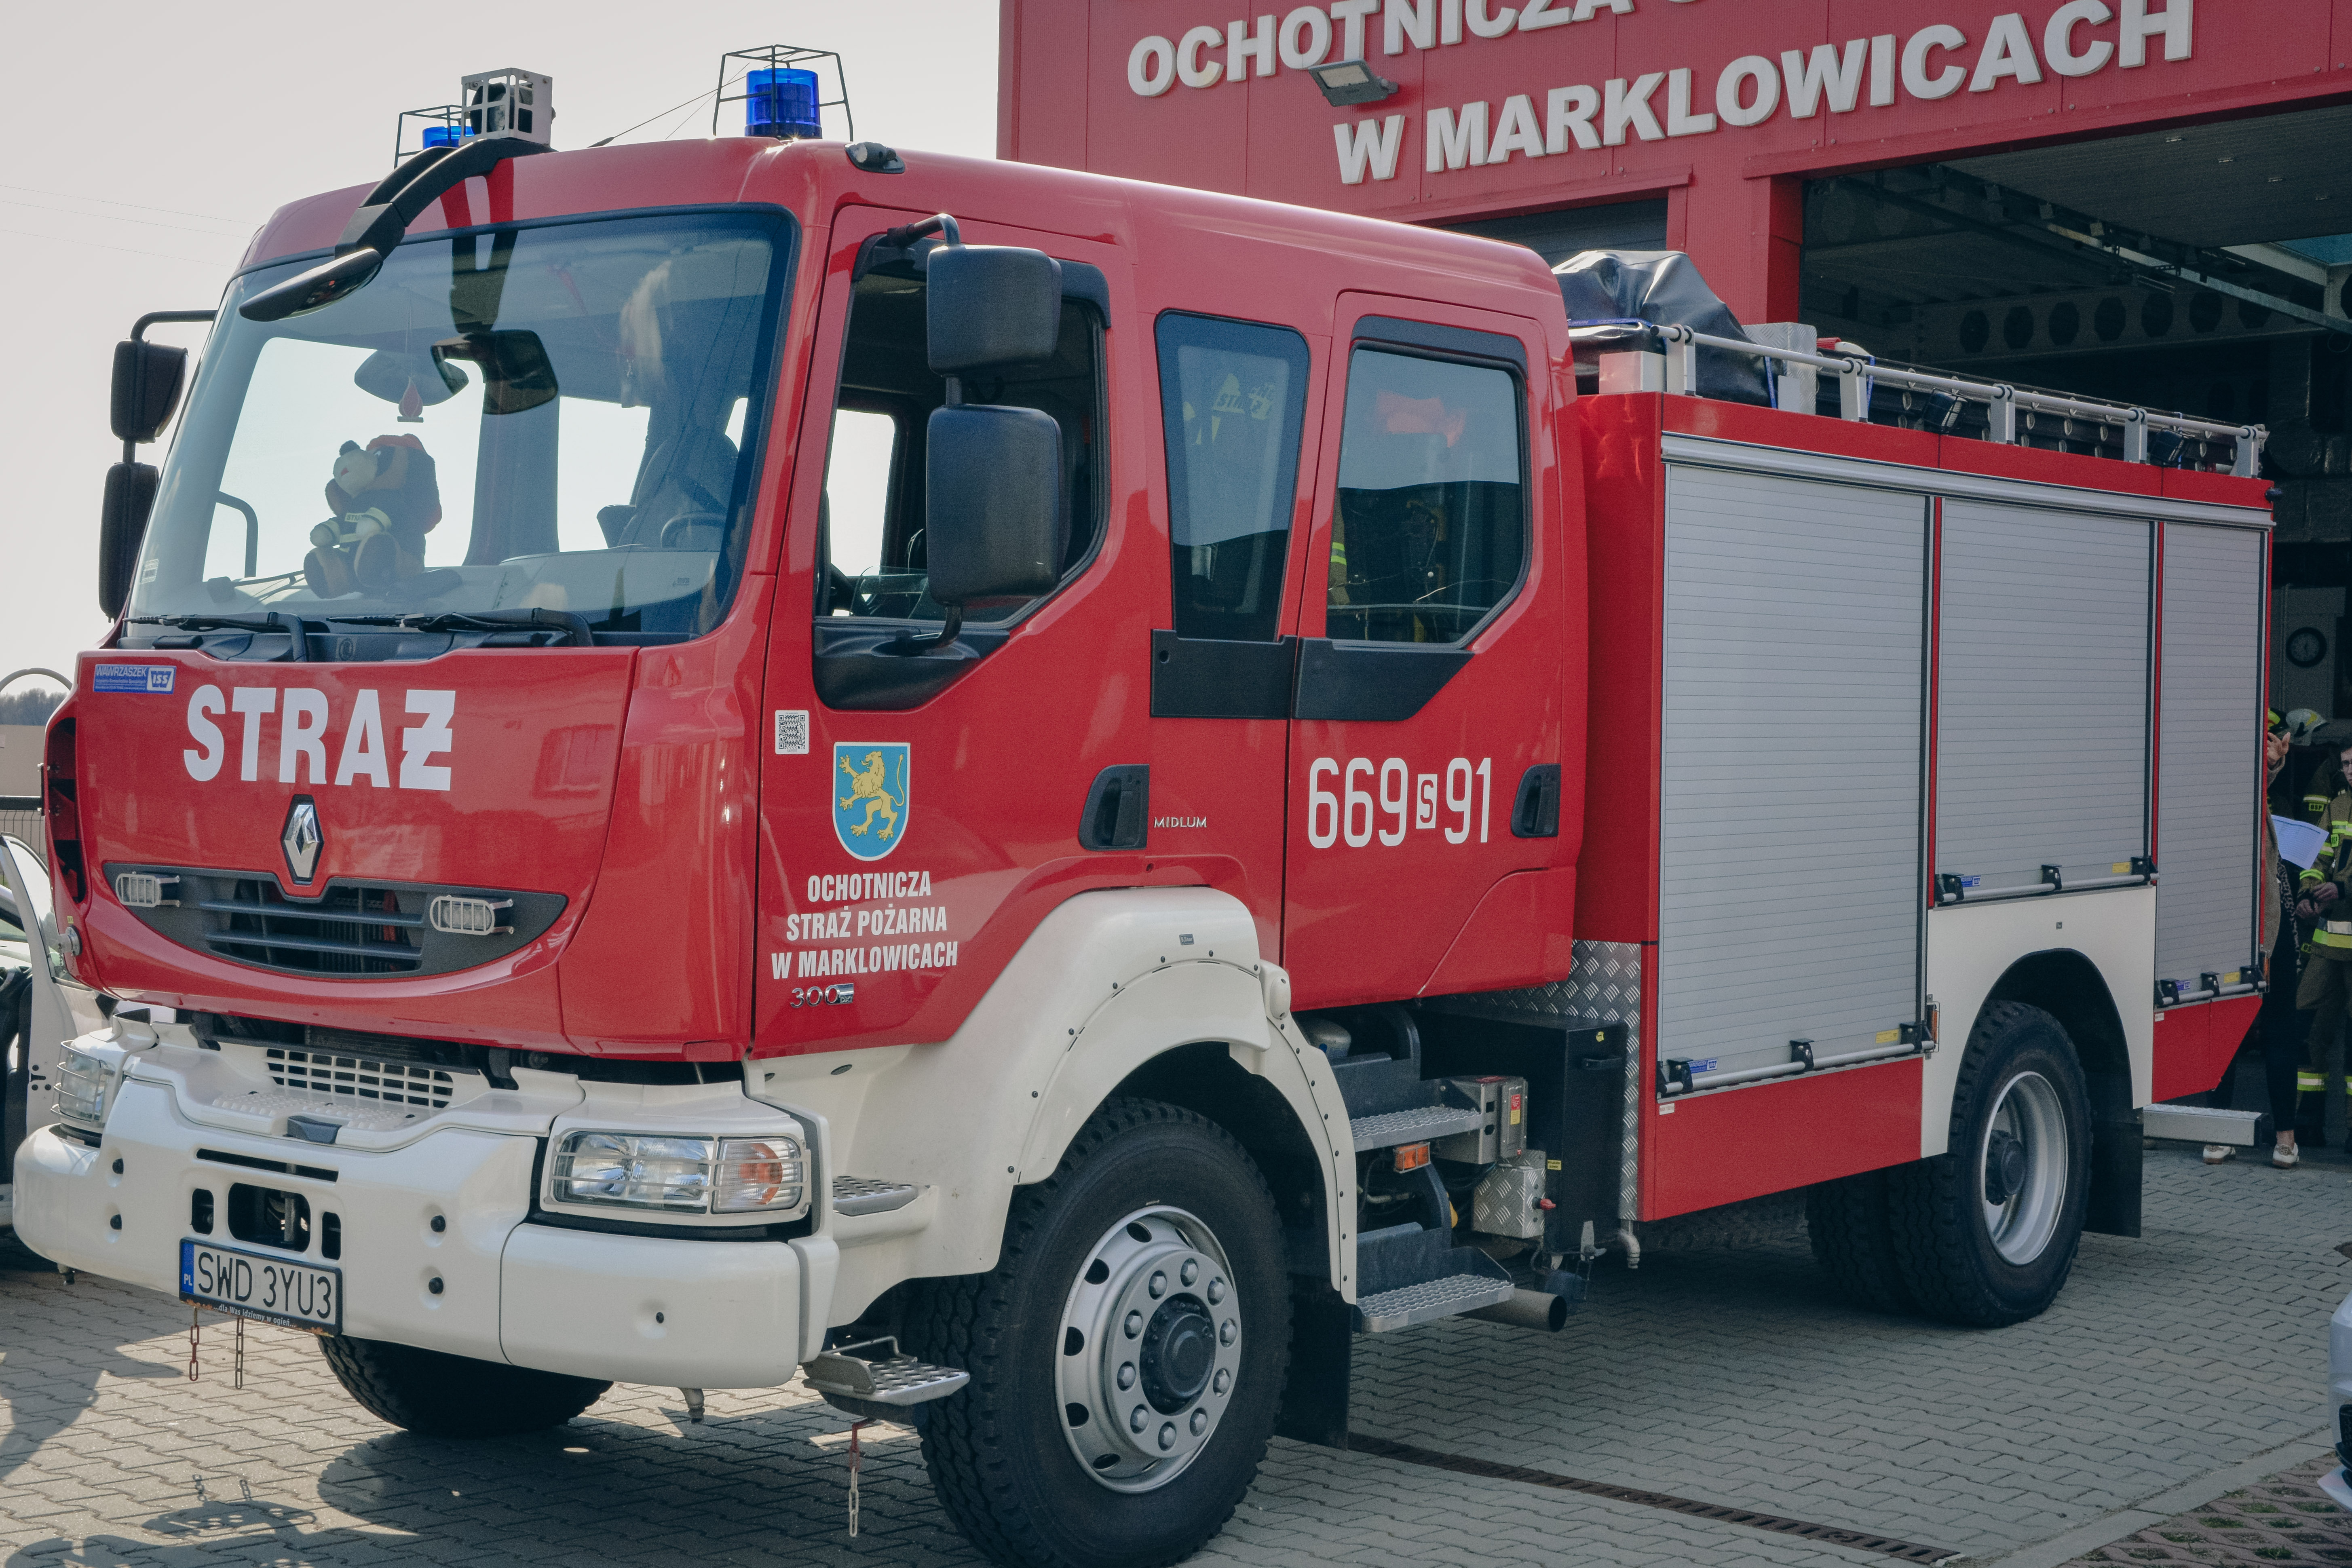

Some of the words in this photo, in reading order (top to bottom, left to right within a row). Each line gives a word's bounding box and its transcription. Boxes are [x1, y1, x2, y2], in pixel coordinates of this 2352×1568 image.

[1333, 114, 1406, 185] W
[1426, 0, 2193, 173] MARKLOWICACH
[96, 667, 147, 677] WAWRZASZEK
[153, 674, 168, 684] ISS
[1153, 816, 1207, 828] MIDLUM
[807, 871, 931, 902] OCHOTNICZA
[786, 905, 851, 941] STRAŻ
[857, 903, 947, 936] POŻARNA
[771, 952, 792, 979] W
[798, 941, 958, 978] MARKLOWICACH
[790, 984, 840, 1008] 300
[184, 1274, 192, 1286] PL
[198, 1251, 253, 1302] SWD
[263, 1265, 331, 1319] 3YU3
[230, 1306, 241, 1315] Was
[243, 1309, 265, 1322] idziemy
